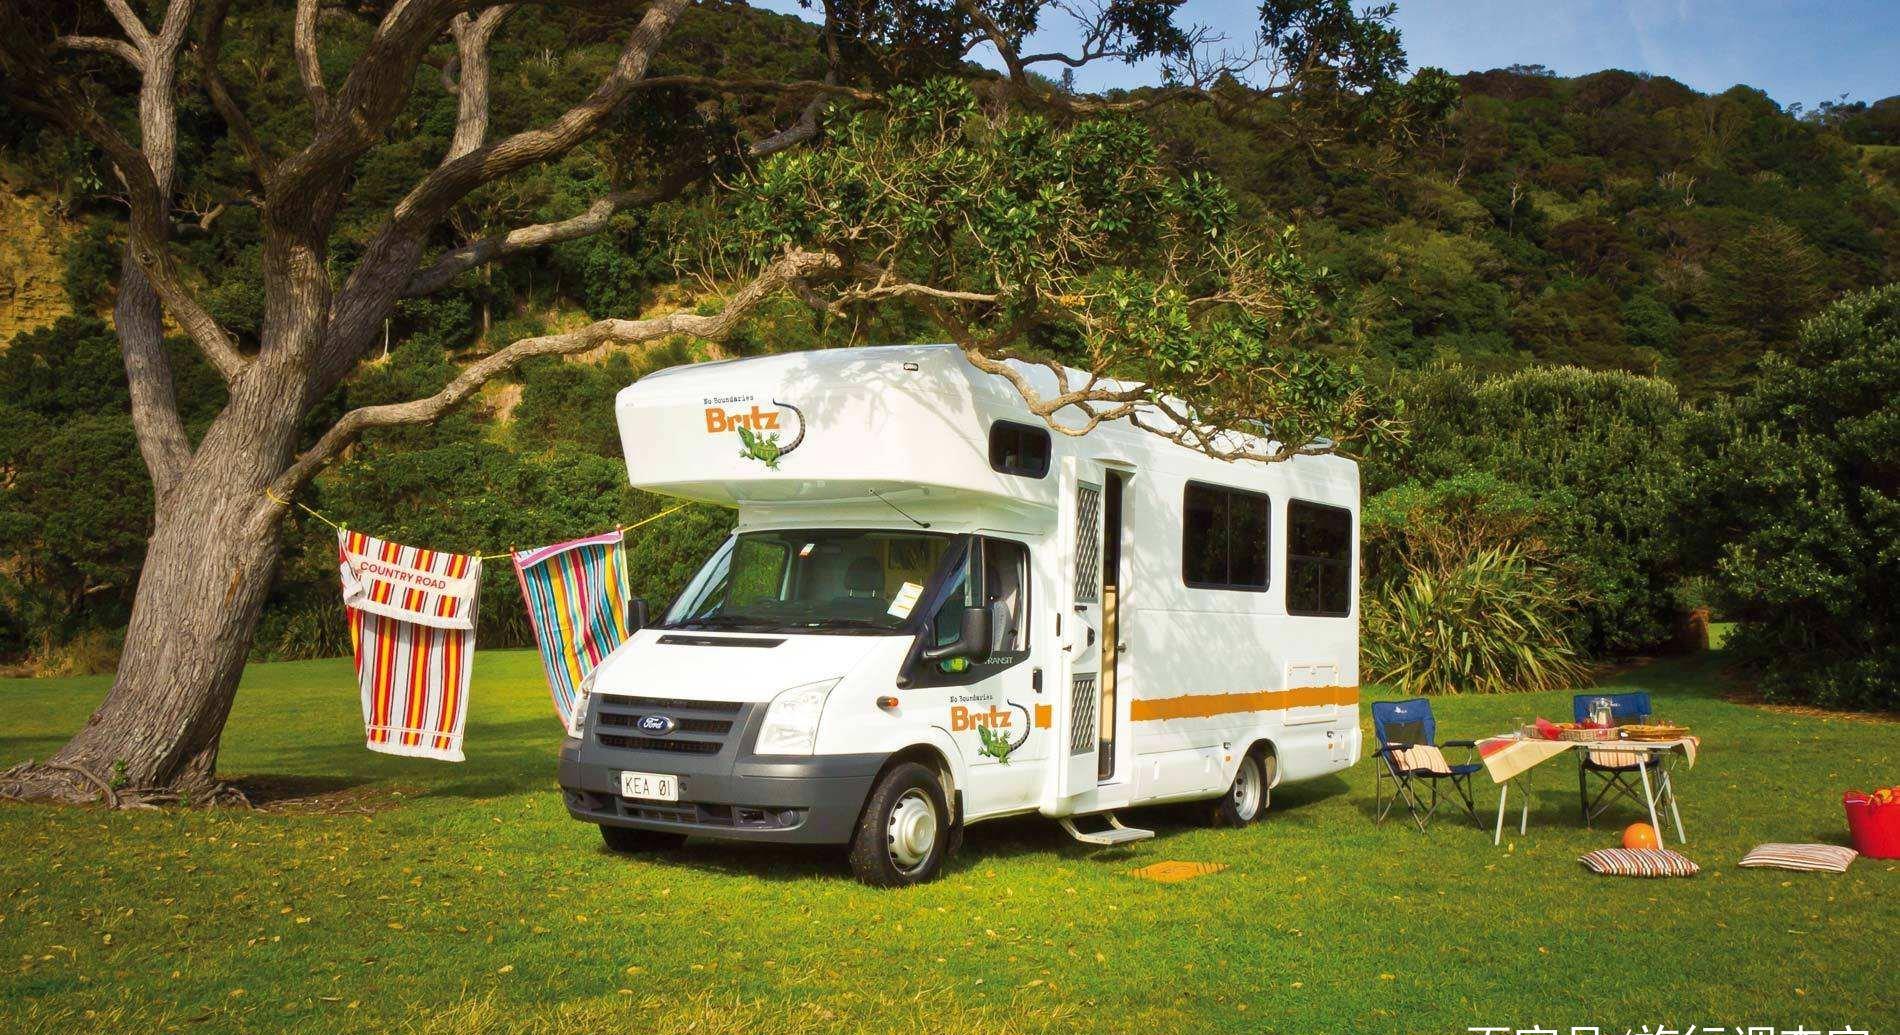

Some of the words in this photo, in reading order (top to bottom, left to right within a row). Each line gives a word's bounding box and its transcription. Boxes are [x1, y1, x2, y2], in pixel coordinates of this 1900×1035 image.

[713, 394, 754, 404] Boundaries
[705, 405, 780, 433] Britz
[360, 561, 414, 583] COUNTRY
[415, 575, 446, 590] ROAD
[643, 717, 664, 729] Ford
[951, 704, 1012, 732] Britz
[625, 777, 651, 796] KEA
